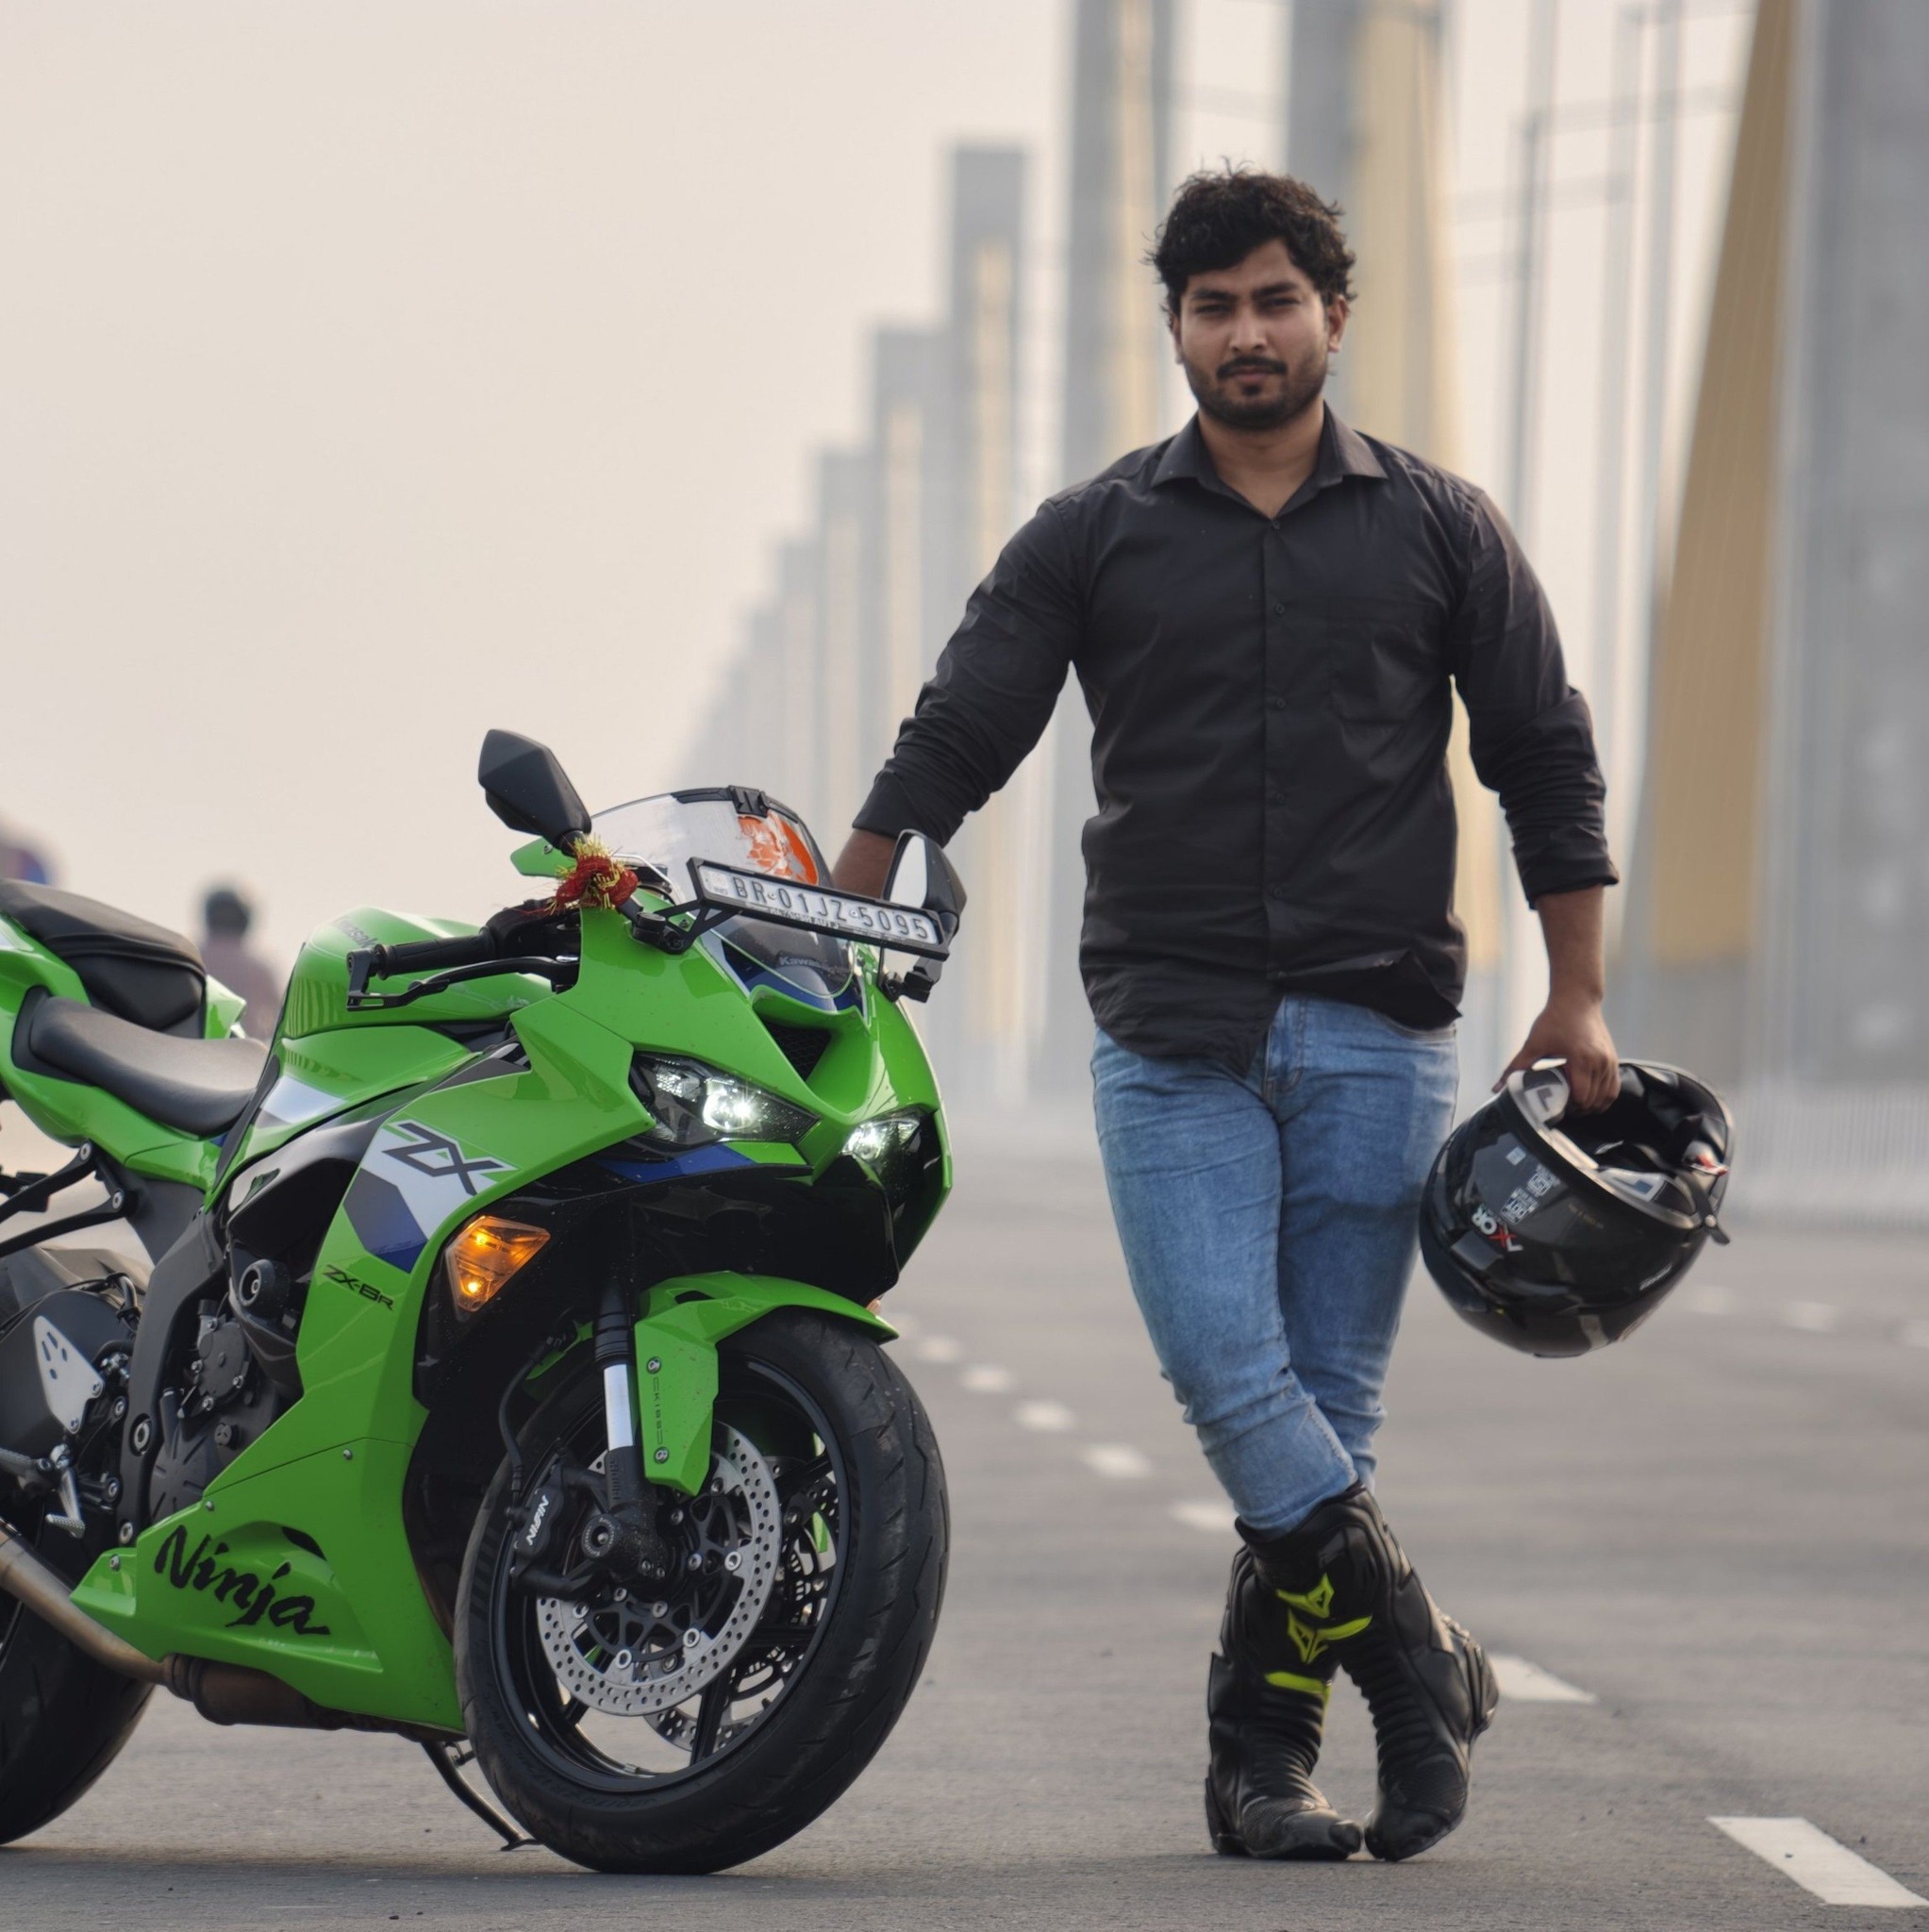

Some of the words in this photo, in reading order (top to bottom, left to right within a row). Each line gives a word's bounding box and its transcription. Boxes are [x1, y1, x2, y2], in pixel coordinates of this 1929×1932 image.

[380, 1121, 505, 1197] ZX
[324, 1264, 394, 1311] ZX-6R
[154, 1524, 331, 1636] Ninja
